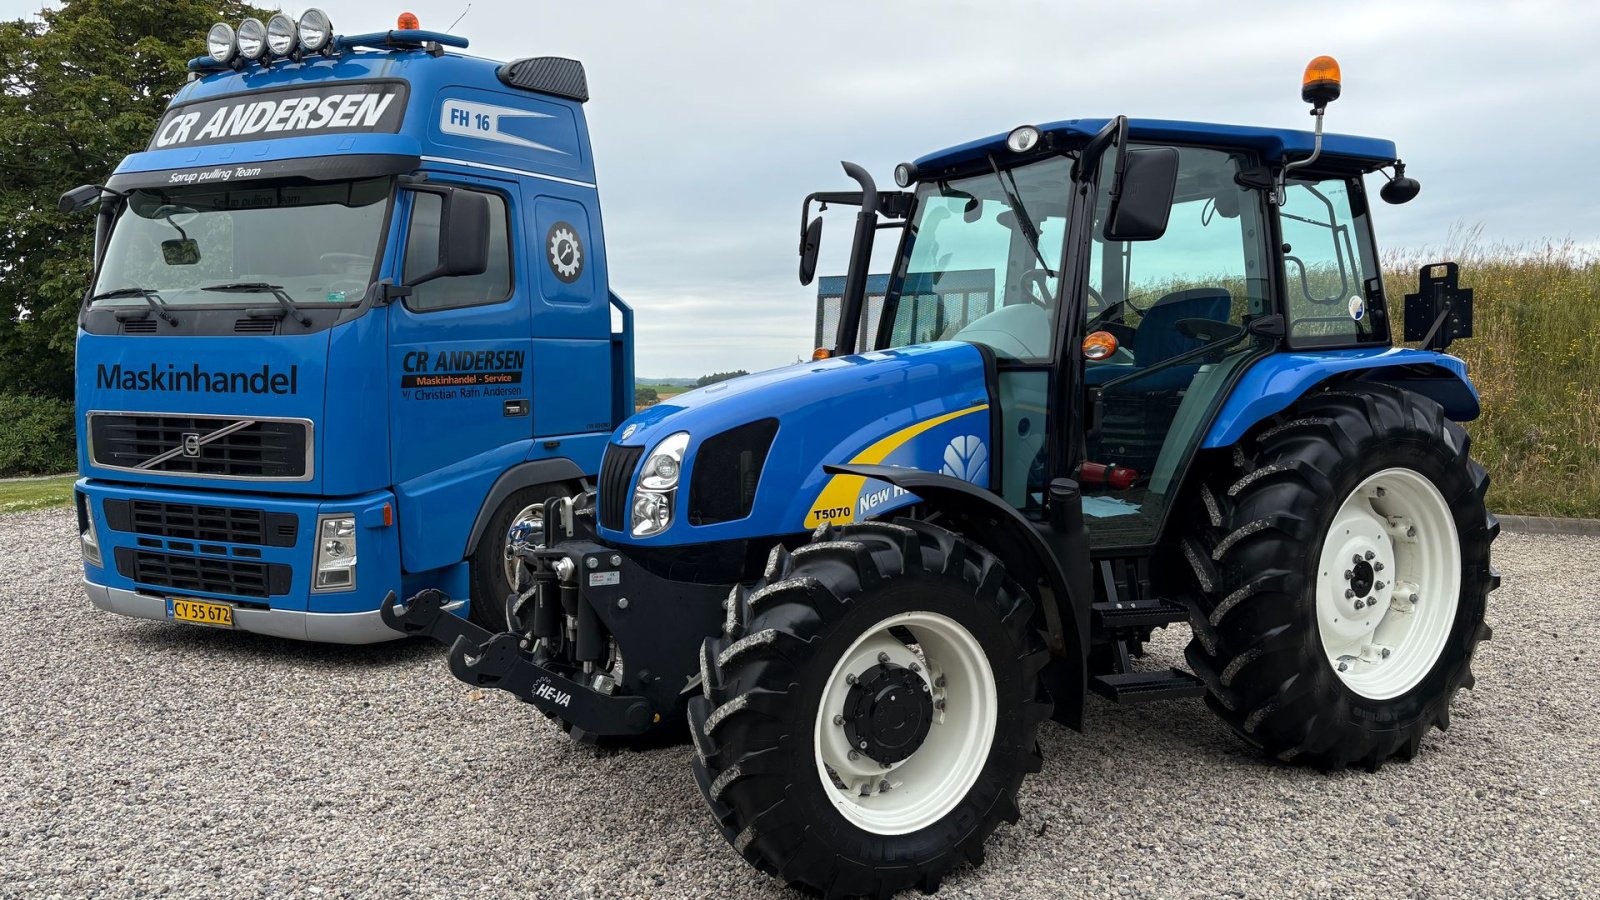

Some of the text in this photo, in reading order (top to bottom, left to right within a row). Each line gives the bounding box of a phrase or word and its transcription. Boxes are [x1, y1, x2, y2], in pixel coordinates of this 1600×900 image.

[156, 93, 396, 148] CR ANDERSEN
[451, 108, 490, 131] FH 16
[169, 167, 261, 184] Sørup pulling Team
[403, 350, 526, 372] CR ANDERSEN
[97, 363, 297, 395] Maskinhandel
[416, 374, 477, 386] Maskinhandel
[484, 373, 512, 383] Service
[415, 388, 457, 401] Christian
[460, 386, 480, 399] Rafn
[483, 385, 521, 397] Andersen
[859, 487, 890, 514] New
[814, 506, 851, 520] T5070
[174, 602, 189, 617] CY
[191, 604, 206, 619] 55
[208, 606, 231, 622] 672
[535, 683, 571, 707] HE-VA
